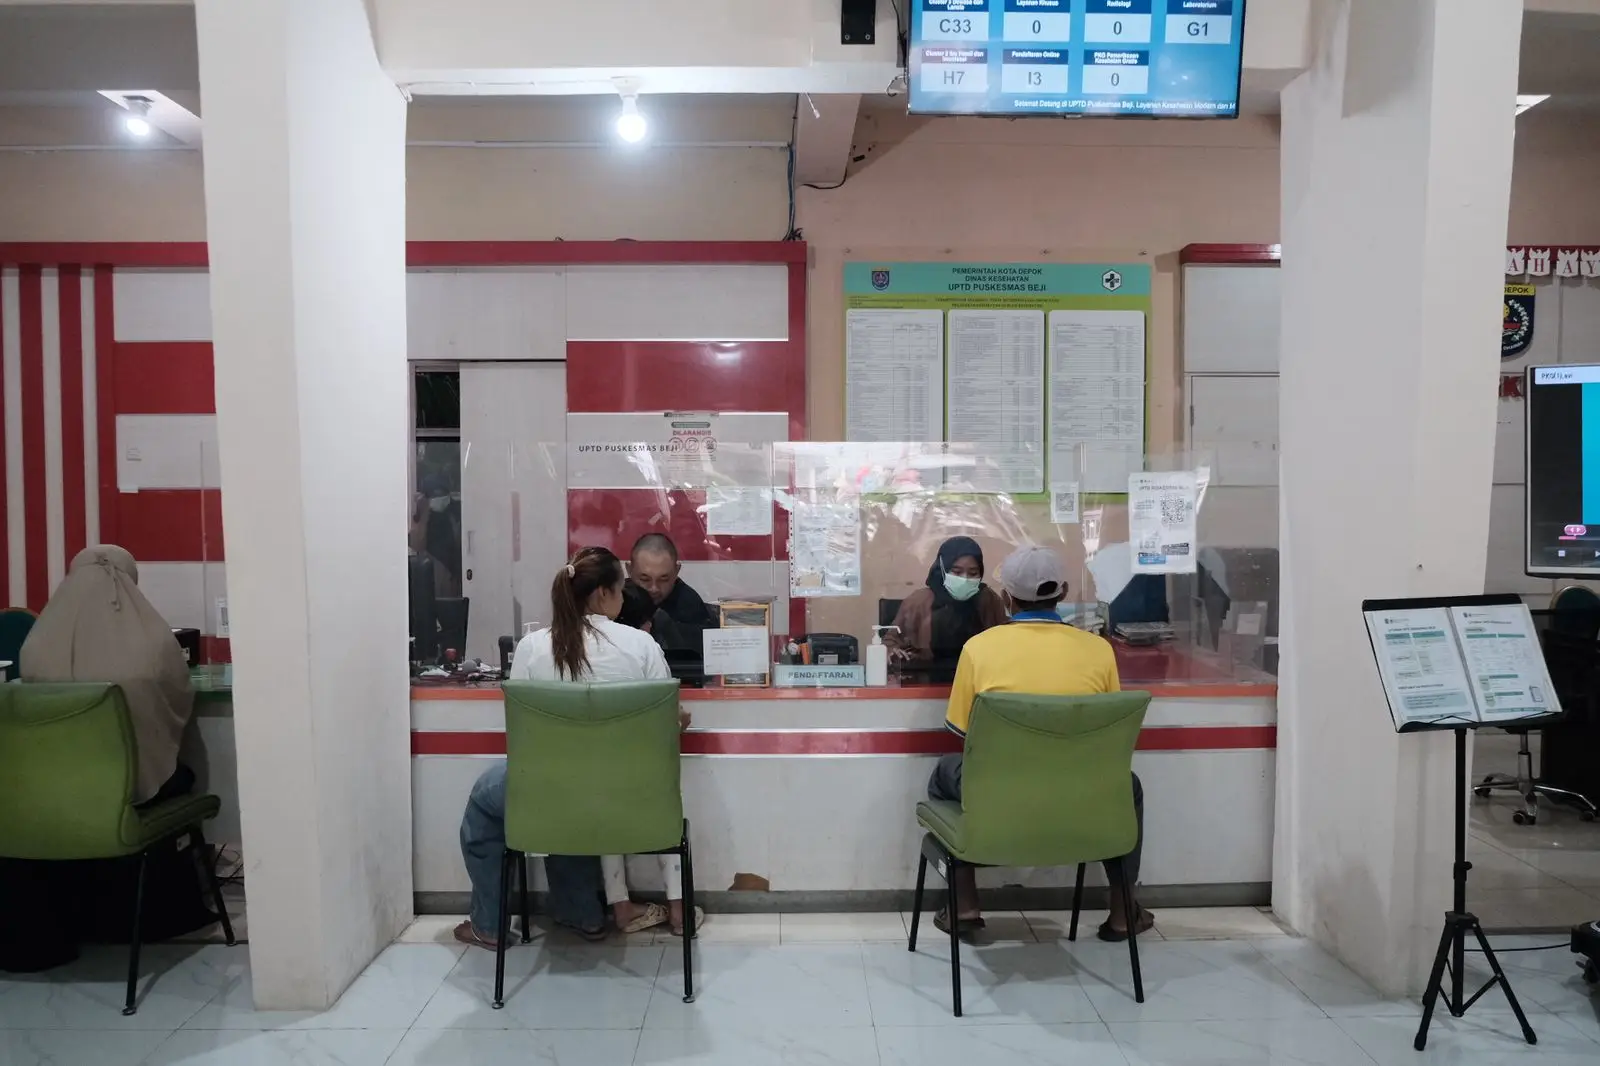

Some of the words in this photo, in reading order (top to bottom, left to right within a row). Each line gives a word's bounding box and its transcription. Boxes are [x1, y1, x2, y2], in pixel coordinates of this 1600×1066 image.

[1106, 0, 1132, 8] Radiologi
[939, 18, 972, 33] C33
[1032, 19, 1041, 34] 0
[1113, 21, 1122, 35] 0
[1187, 22, 1209, 36] G1
[943, 70, 965, 85] H7
[1111, 73, 1120, 87] 0
[1014, 100, 1039, 108] Selamat
[1039, 100, 1061, 109] Datang
[1068, 100, 1086, 108] UPTD
[1087, 101, 1121, 109] Puskesmas
[952, 267, 996, 275] PEMERINTAH
[1018, 268, 1042, 276] DEPOK
[988, 275, 1029, 283] KESEHATAN
[948, 283, 971, 291] UPTD
[973, 283, 1025, 292] PUSKESMAS
[1027, 284, 1046, 292] BEJI
[579, 445, 602, 453] UPTD
[604, 445, 657, 453] PUSKESMAS
[660, 445, 678, 453] BEJI
[788, 671, 854, 679] PENDAFTARAN
